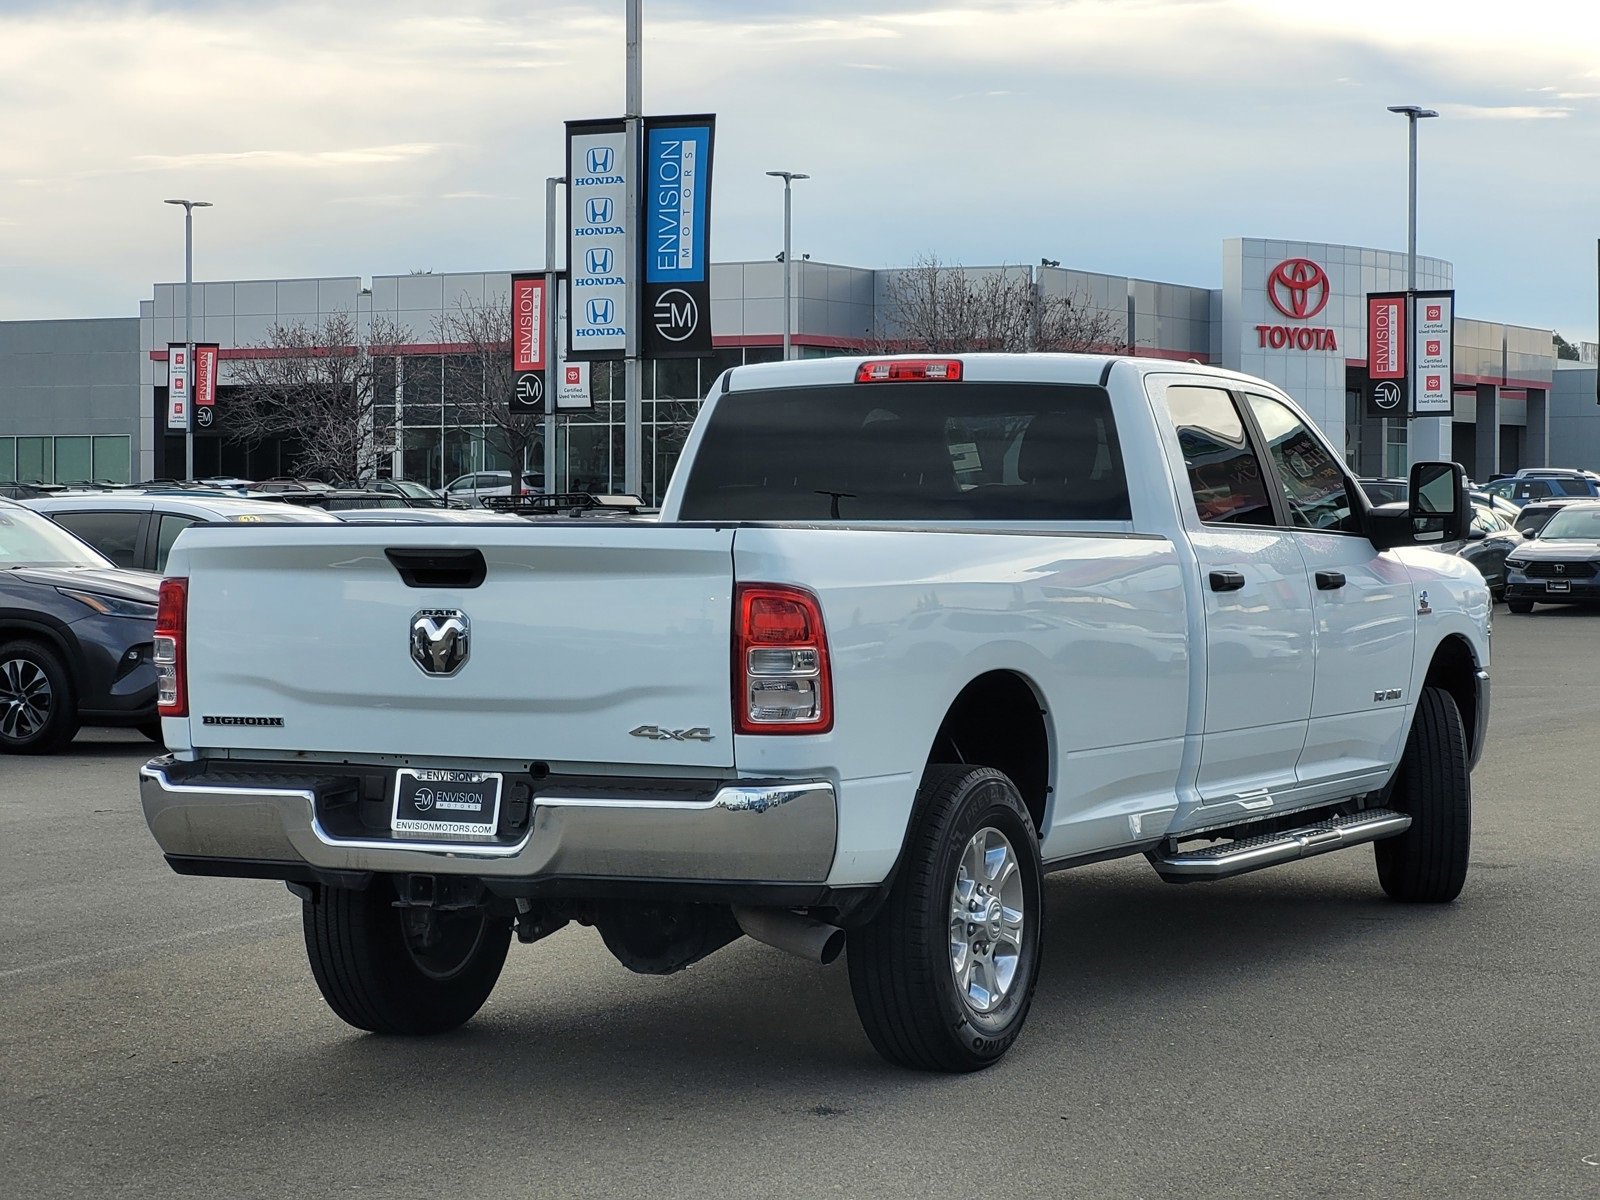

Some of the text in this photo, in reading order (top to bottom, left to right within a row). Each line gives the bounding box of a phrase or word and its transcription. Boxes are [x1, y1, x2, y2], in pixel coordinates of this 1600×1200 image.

[575, 176, 625, 186] HONDA
[657, 140, 680, 270] ENVISION
[681, 152, 693, 258] MOTORS
[575, 226, 625, 236] HONDA
[575, 277, 626, 287] HONDA
[520, 287, 533, 364] ENVISION
[576, 328, 626, 337] HONDA
[1255, 325, 1338, 351] TOYOTA
[1376, 304, 1389, 373] ENVISION
[199, 351, 208, 401] ENVISION
[202, 716, 284, 727] BIGHORN
[426, 771, 473, 782] ENVISION
[436, 791, 483, 804] ENVISION
[396, 821, 492, 834] ENVISIONMOTORS.COM
